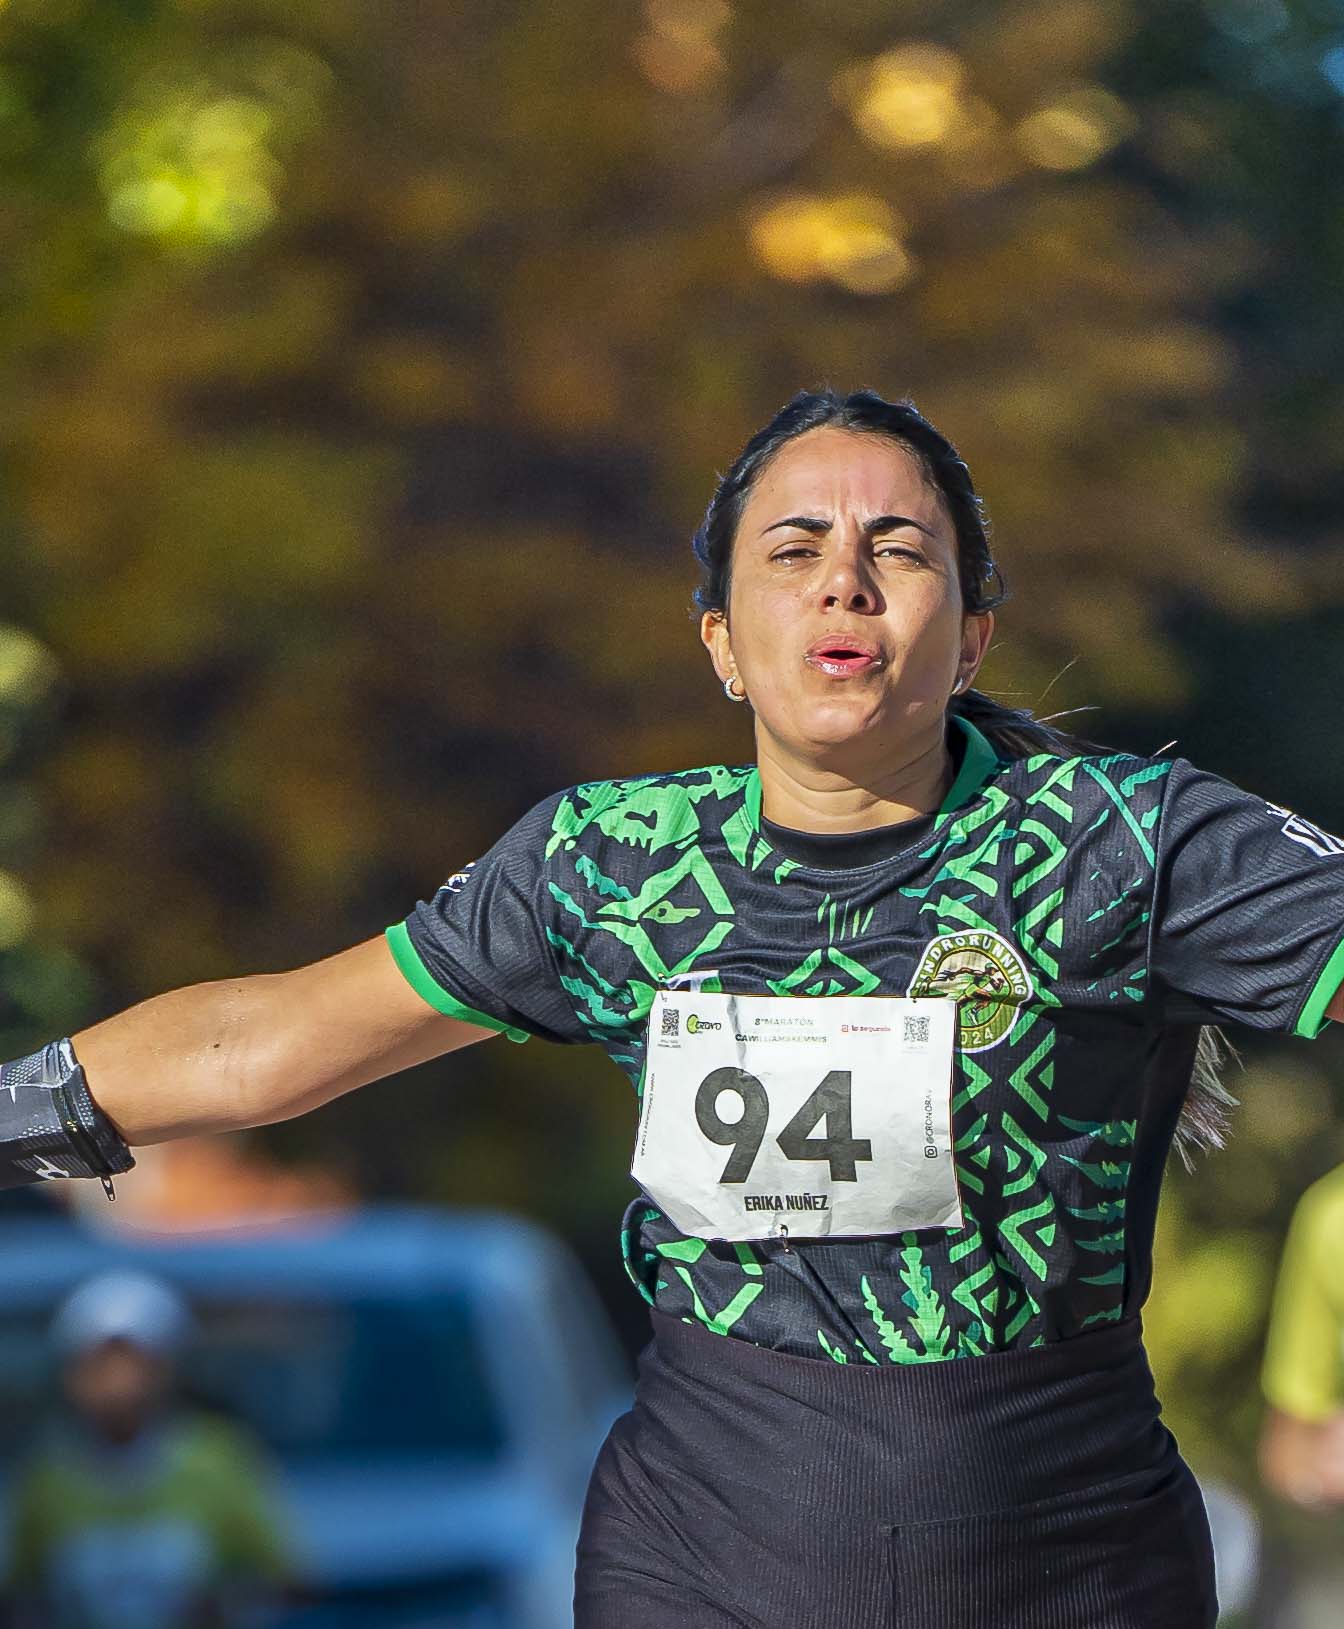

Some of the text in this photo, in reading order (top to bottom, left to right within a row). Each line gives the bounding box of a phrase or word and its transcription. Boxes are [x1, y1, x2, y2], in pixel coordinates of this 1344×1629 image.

[915, 934, 1027, 995] NDRORUNNING
[960, 1027, 994, 1046] 024
[695, 1067, 872, 1183] 94
[744, 1192, 829, 1211] ERIKA NUÑEZ
